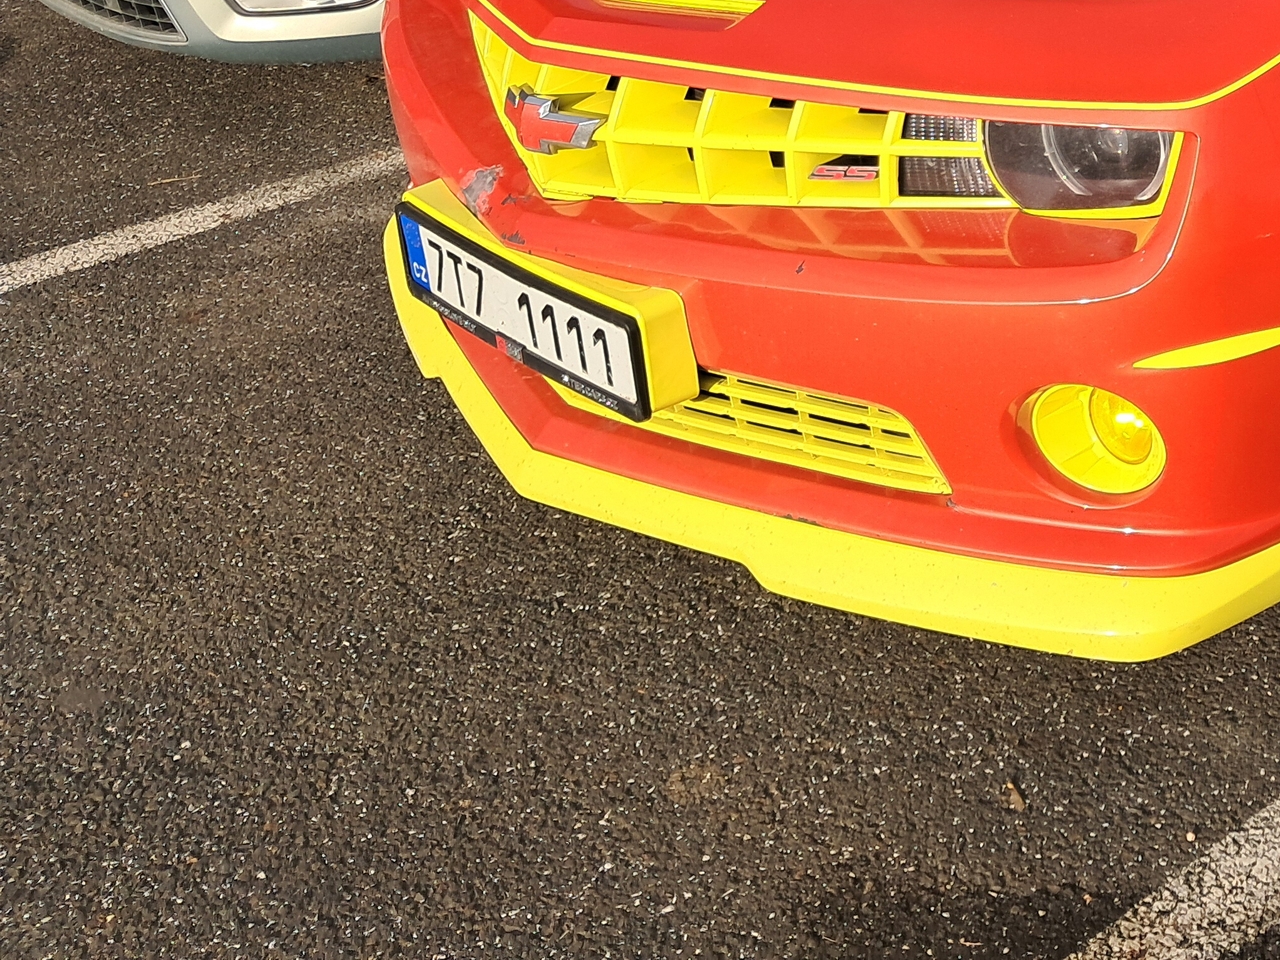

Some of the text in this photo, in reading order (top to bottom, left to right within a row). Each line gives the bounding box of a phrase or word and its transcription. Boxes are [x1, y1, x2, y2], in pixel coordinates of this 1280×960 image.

[807, 165, 879, 182] SS
[413, 261, 428, 283] CZ
[427, 237, 483, 318] 7T7
[517, 291, 615, 388] 1111
